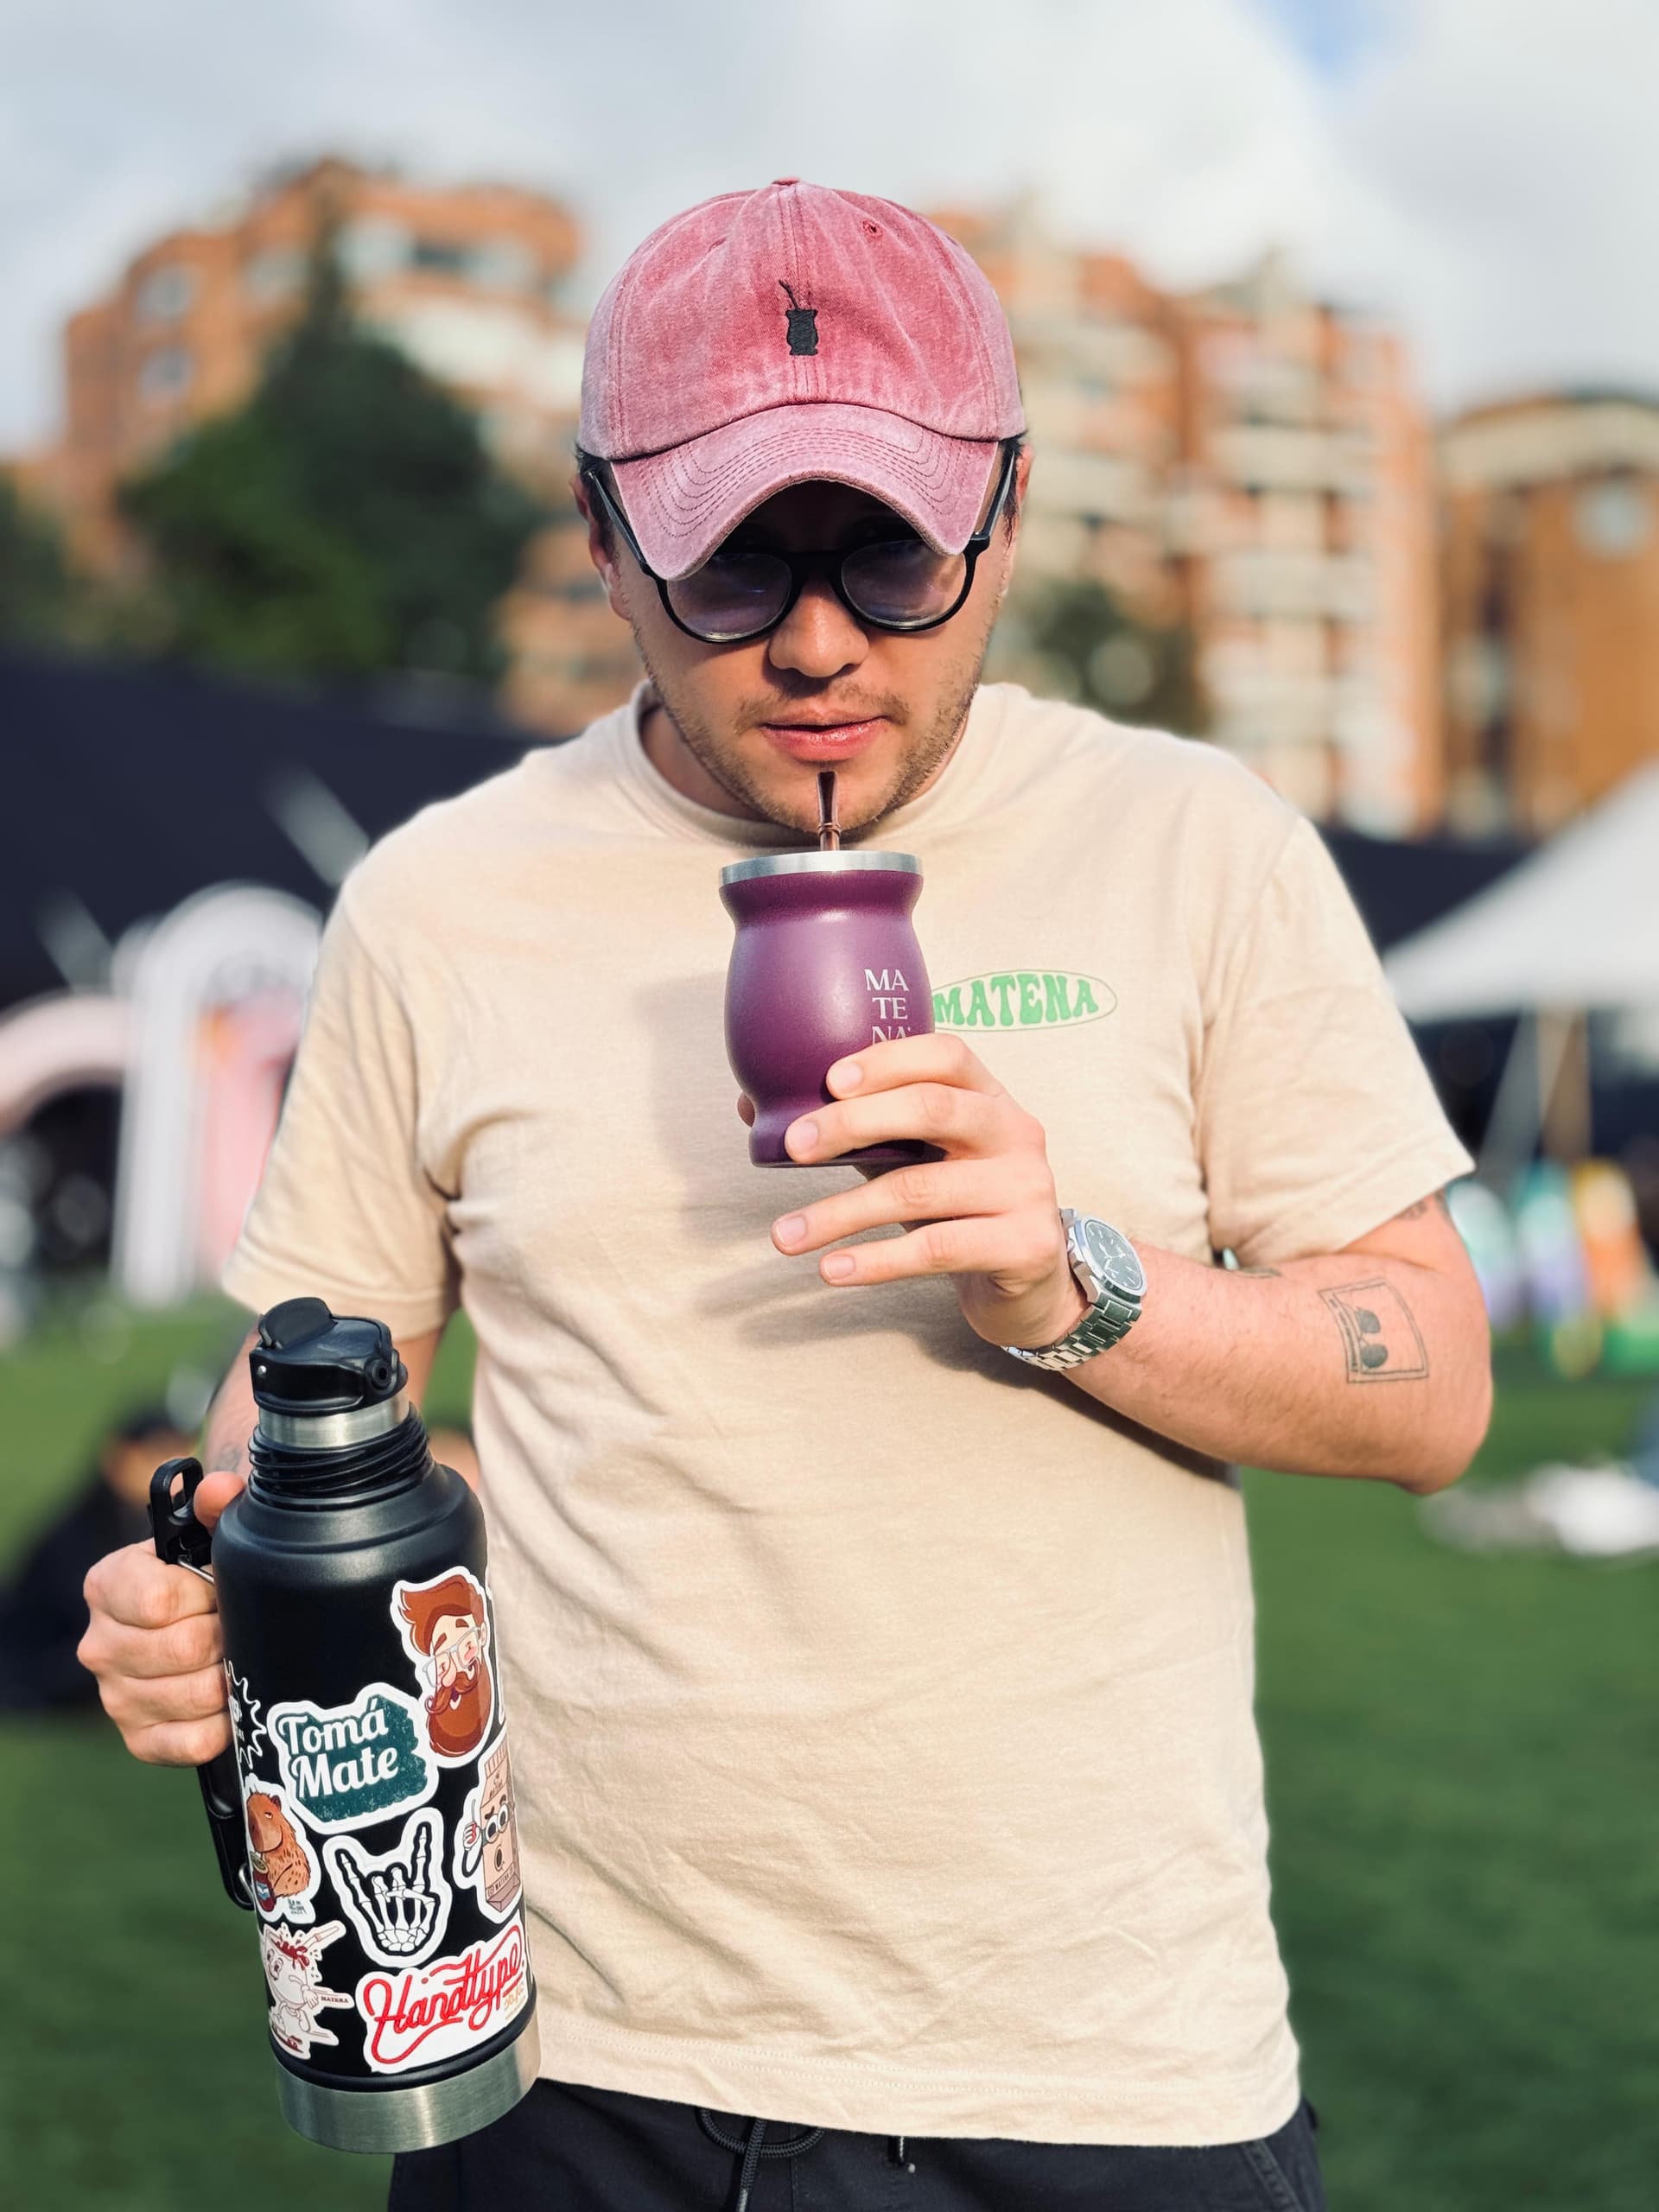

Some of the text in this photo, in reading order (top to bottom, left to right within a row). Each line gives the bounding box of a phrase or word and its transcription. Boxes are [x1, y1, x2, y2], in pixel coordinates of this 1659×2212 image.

[864, 969, 910, 991] MA
[933, 973, 1099, 1027] MATENA
[872, 997, 908, 1020] TE
[277, 1698, 389, 1755] Tomá
[290, 1746, 399, 1798] Mate
